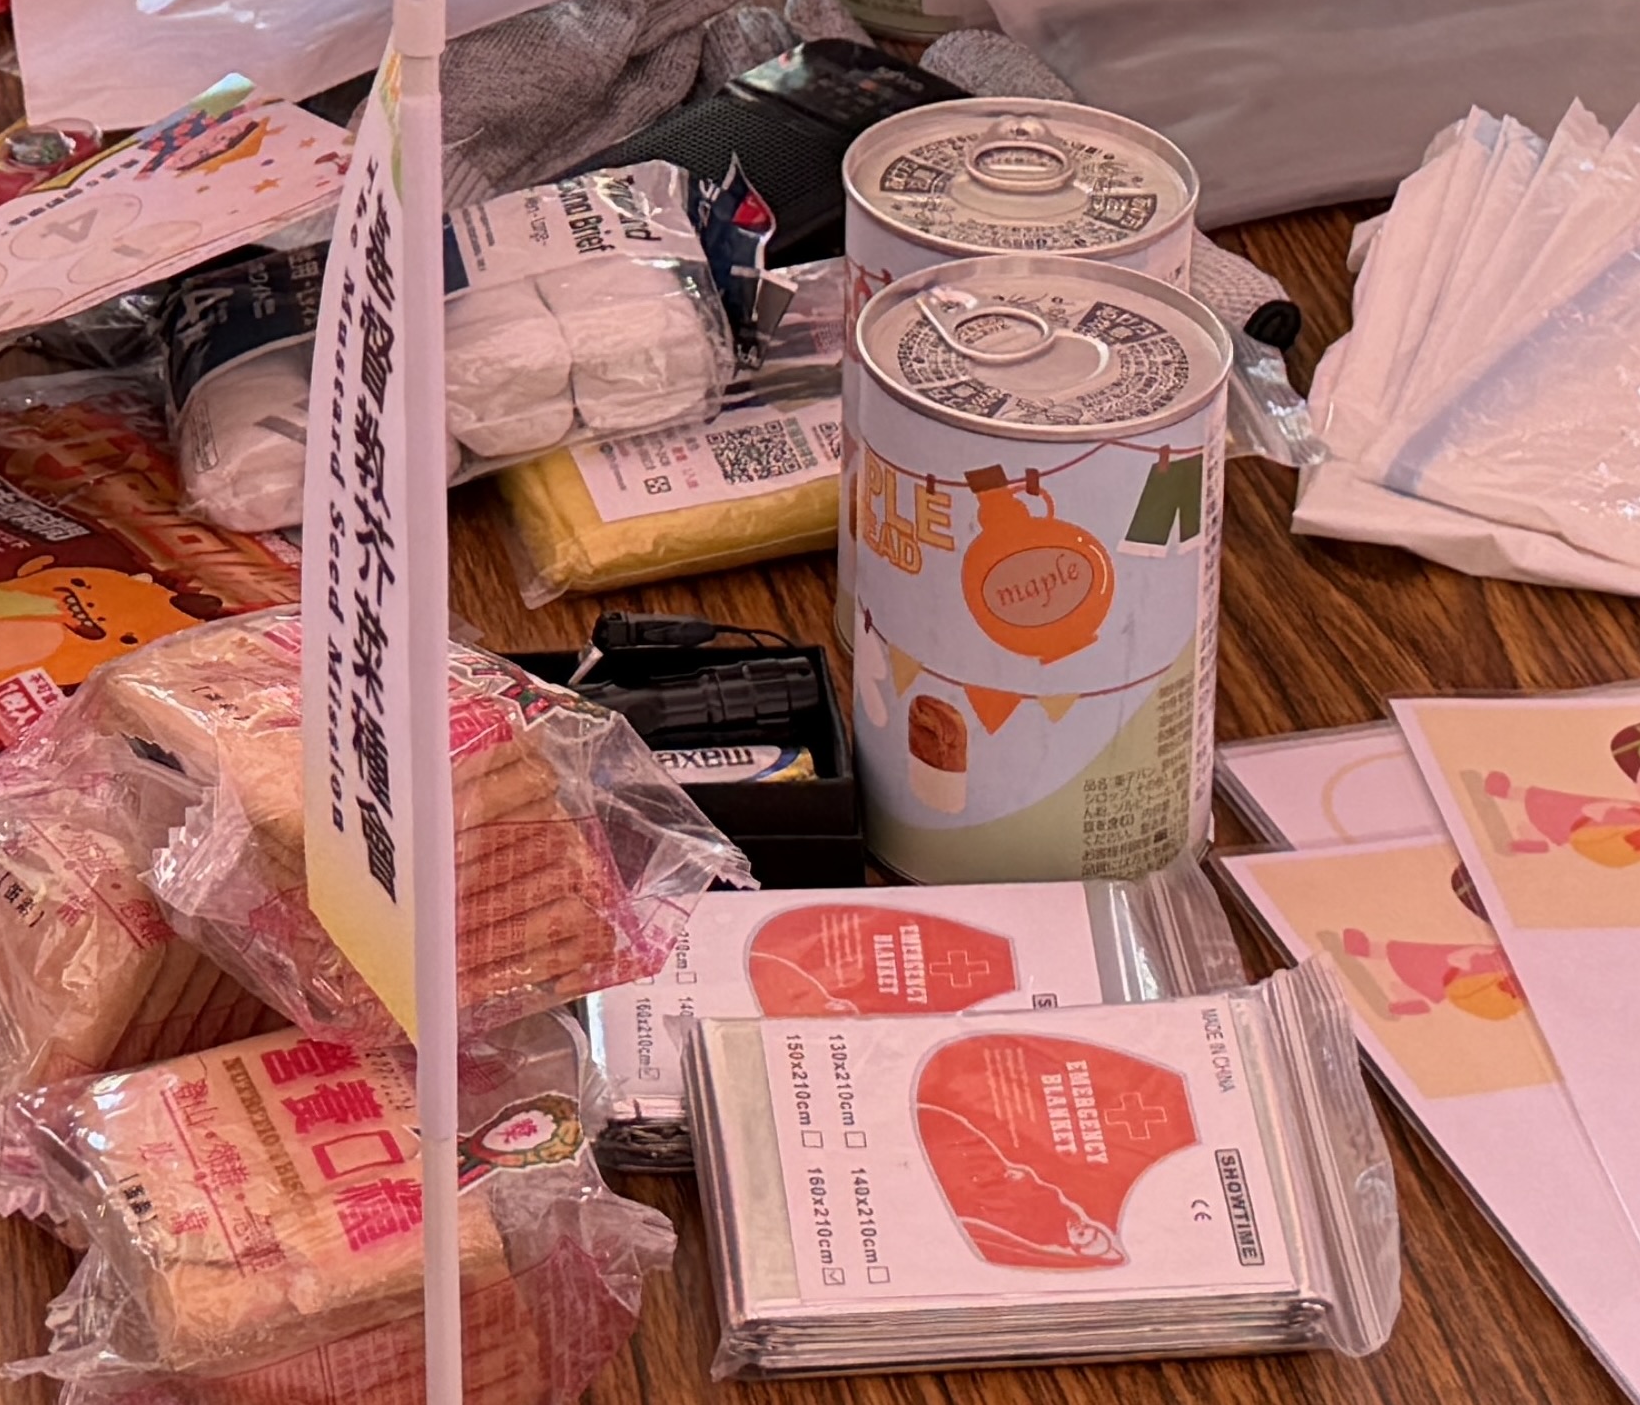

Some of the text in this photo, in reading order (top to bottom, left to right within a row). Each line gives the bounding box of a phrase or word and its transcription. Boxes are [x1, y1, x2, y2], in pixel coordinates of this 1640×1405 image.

[328, 502, 344, 625] Seed
[994, 551, 1082, 609] maple
[326, 628, 344, 832] Mission
[786, 1033, 813, 1128] 150x210cm
[827, 1034, 856, 1128] 130x210cm
[1201, 1007, 1236, 1094] MADE IN CHINA
[1040, 1072, 1075, 1158] BLANKET
[1065, 1058, 1109, 1167] EMERGENCY
[807, 1166, 835, 1266] 160x210cm
[849, 1167, 878, 1265] 140x210cm
[1221, 1154, 1258, 1261] SHOWTIME
